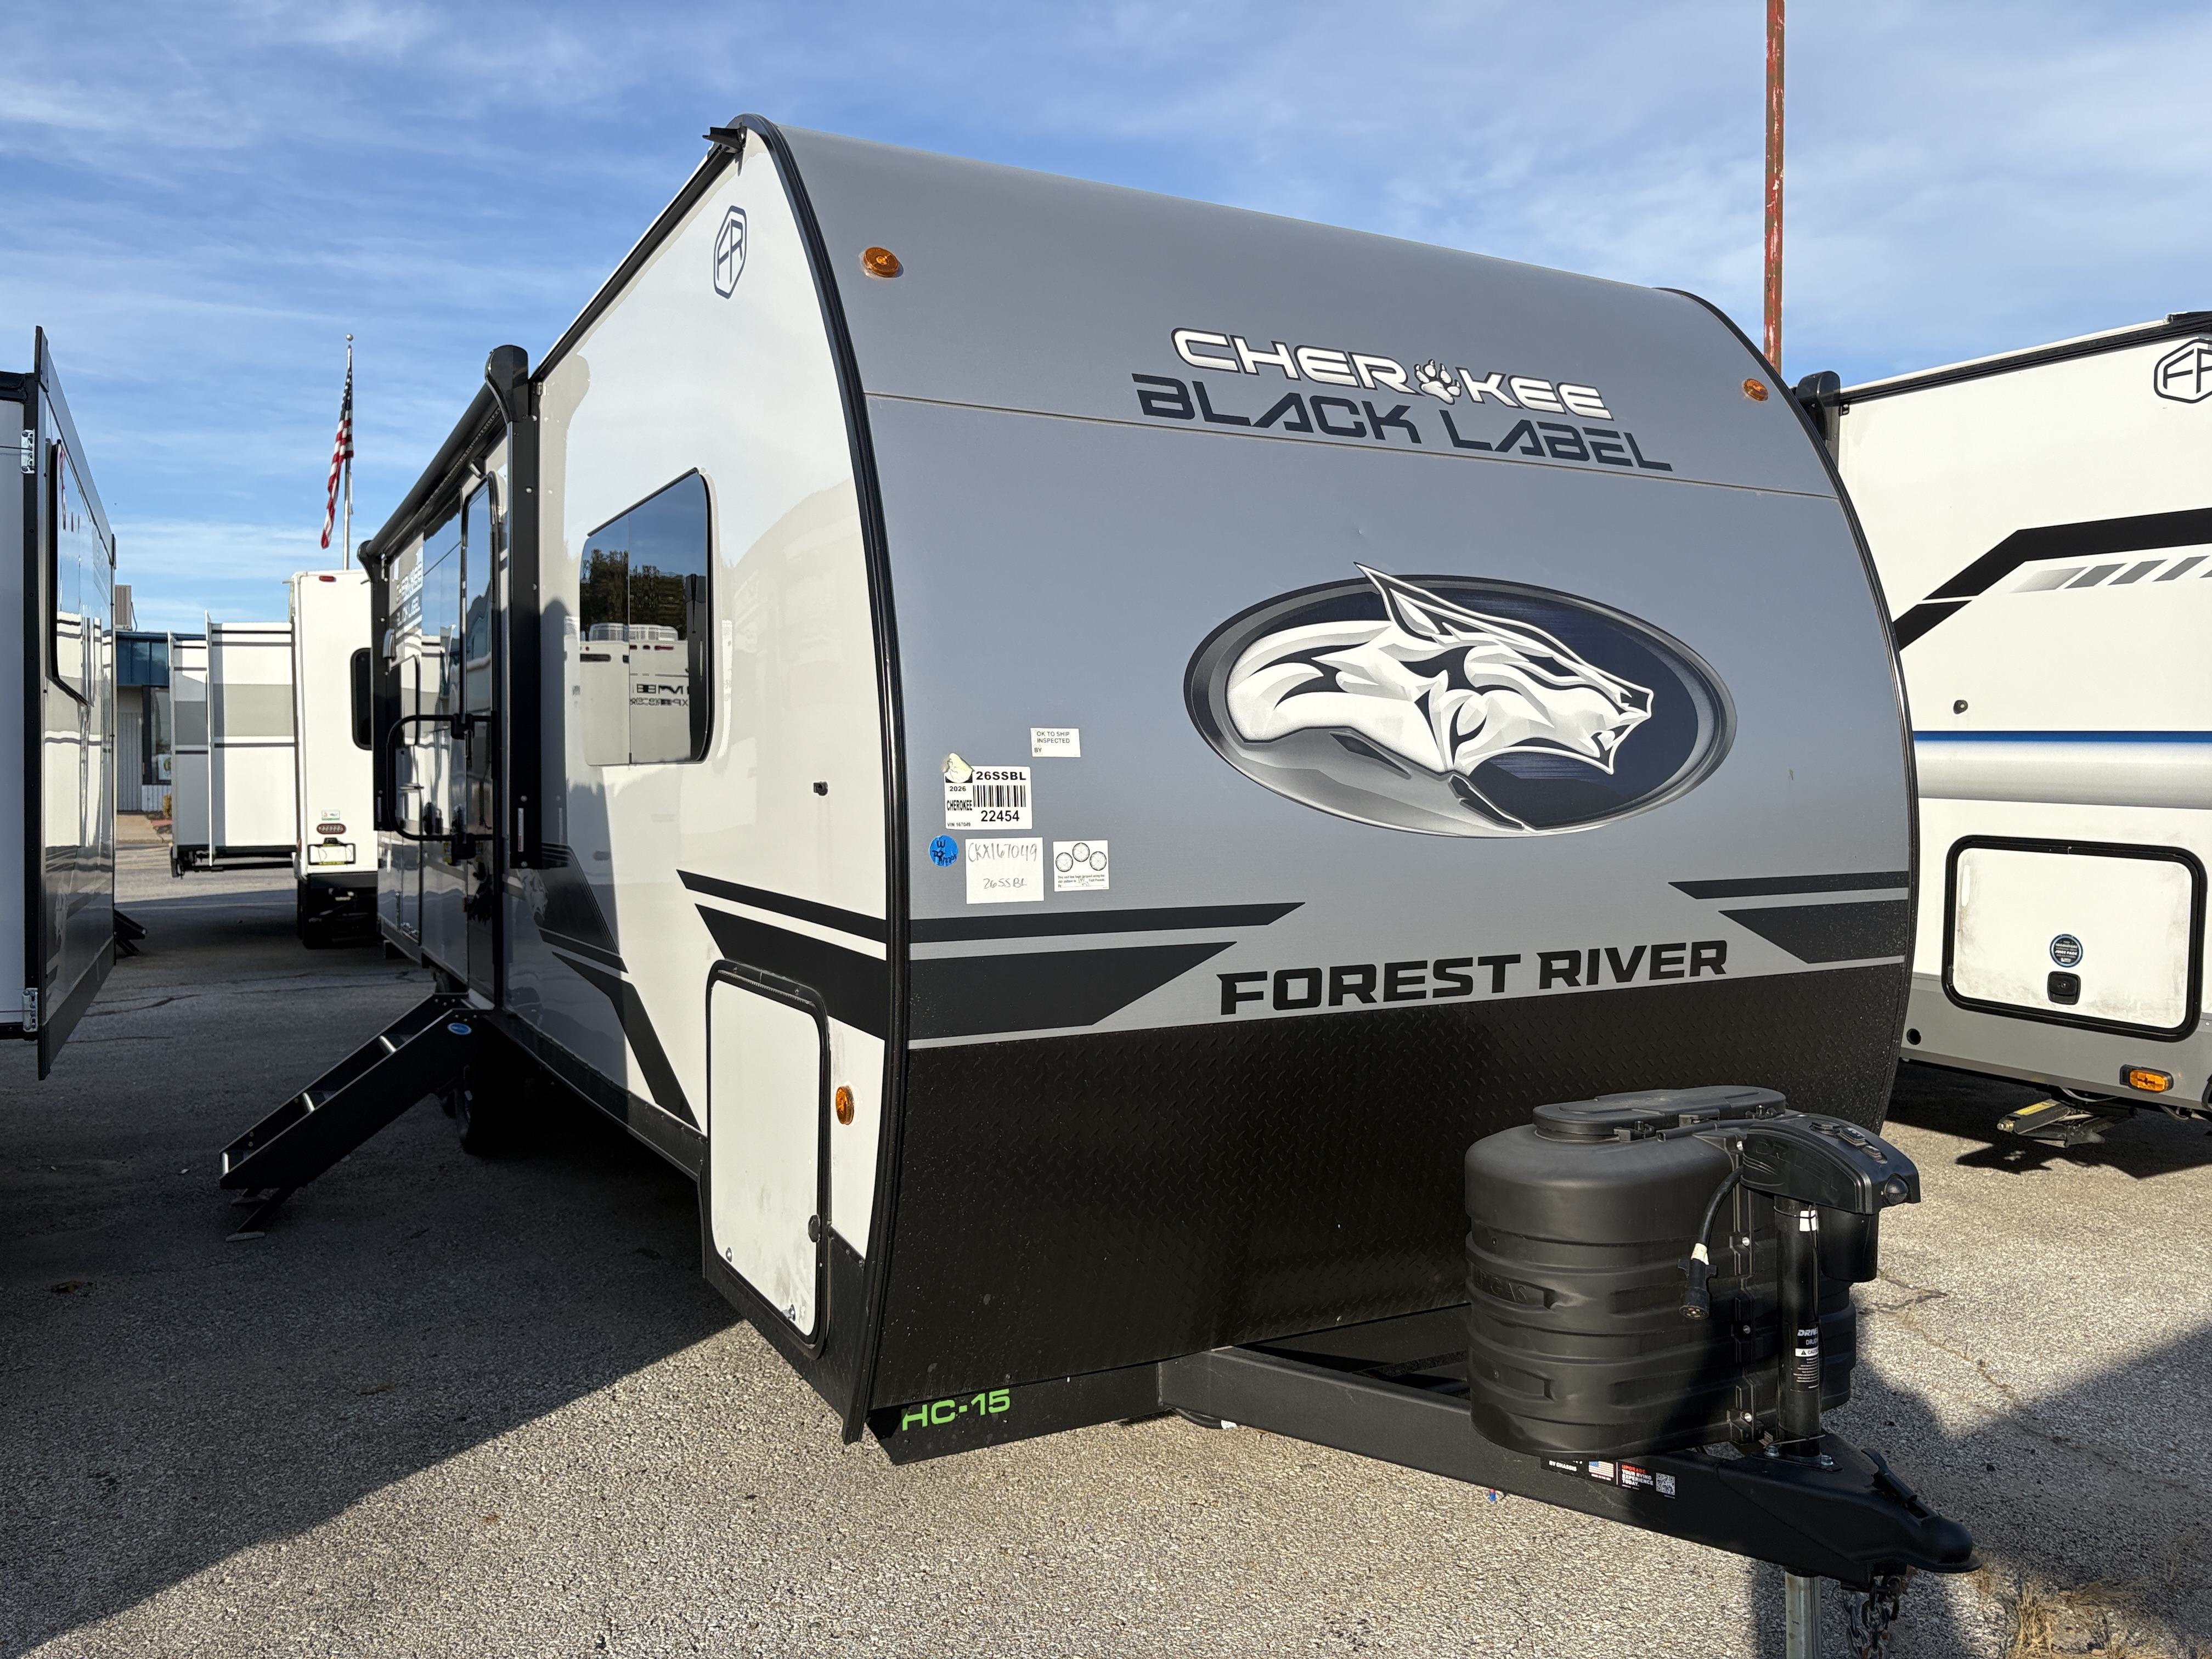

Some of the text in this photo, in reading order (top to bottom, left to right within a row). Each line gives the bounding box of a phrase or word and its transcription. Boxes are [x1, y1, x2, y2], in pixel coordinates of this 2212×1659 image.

[1132, 373, 1673, 471] BLACK LABEL
[975, 771, 1026, 781] 26SSBL
[946, 799, 973, 811] CHEROKEE
[980, 810, 1020, 822] 22454
[968, 842, 1037, 862] CKX167049
[1216, 940, 1728, 1015] FOREST RIVER
[901, 1388, 1011, 1431] HC-15
[1556, 1462, 1577, 1471] CHASSIS
[1622, 1474, 1654, 1486] EXPERIENCE
